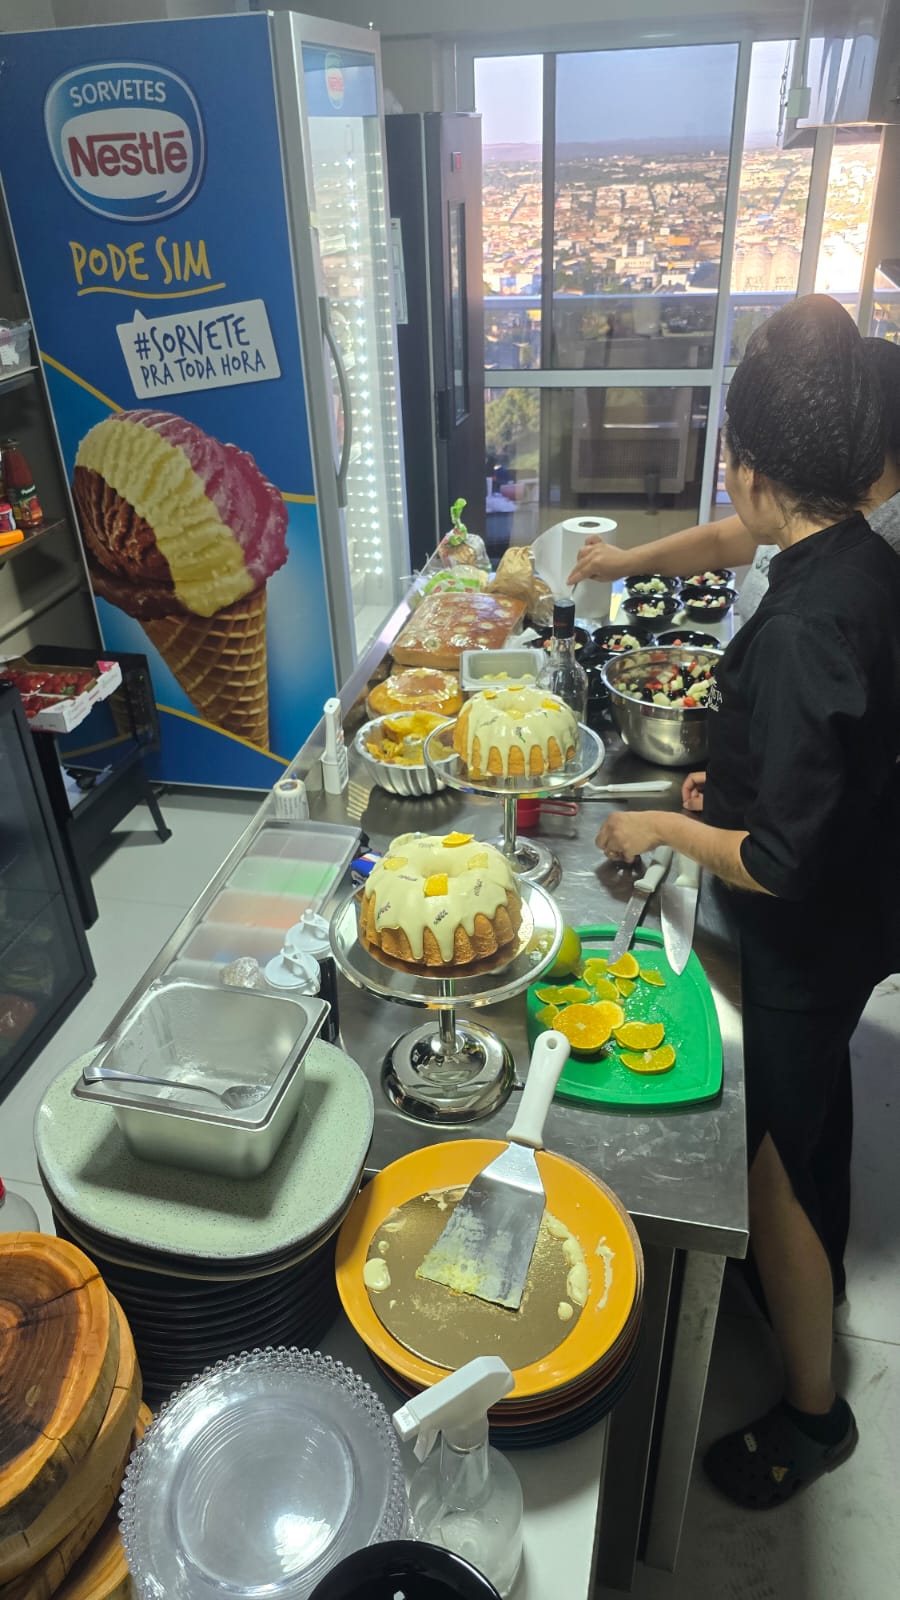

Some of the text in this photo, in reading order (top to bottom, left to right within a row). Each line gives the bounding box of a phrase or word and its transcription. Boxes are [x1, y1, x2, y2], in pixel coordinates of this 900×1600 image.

[69, 79, 167, 108] SORVETES
[67, 130, 188, 177] Nestlé
[68, 236, 212, 286] PODE SIM
[133, 313, 250, 362] #SORVETE
[140, 349, 266, 389] PRA TODA HORA
